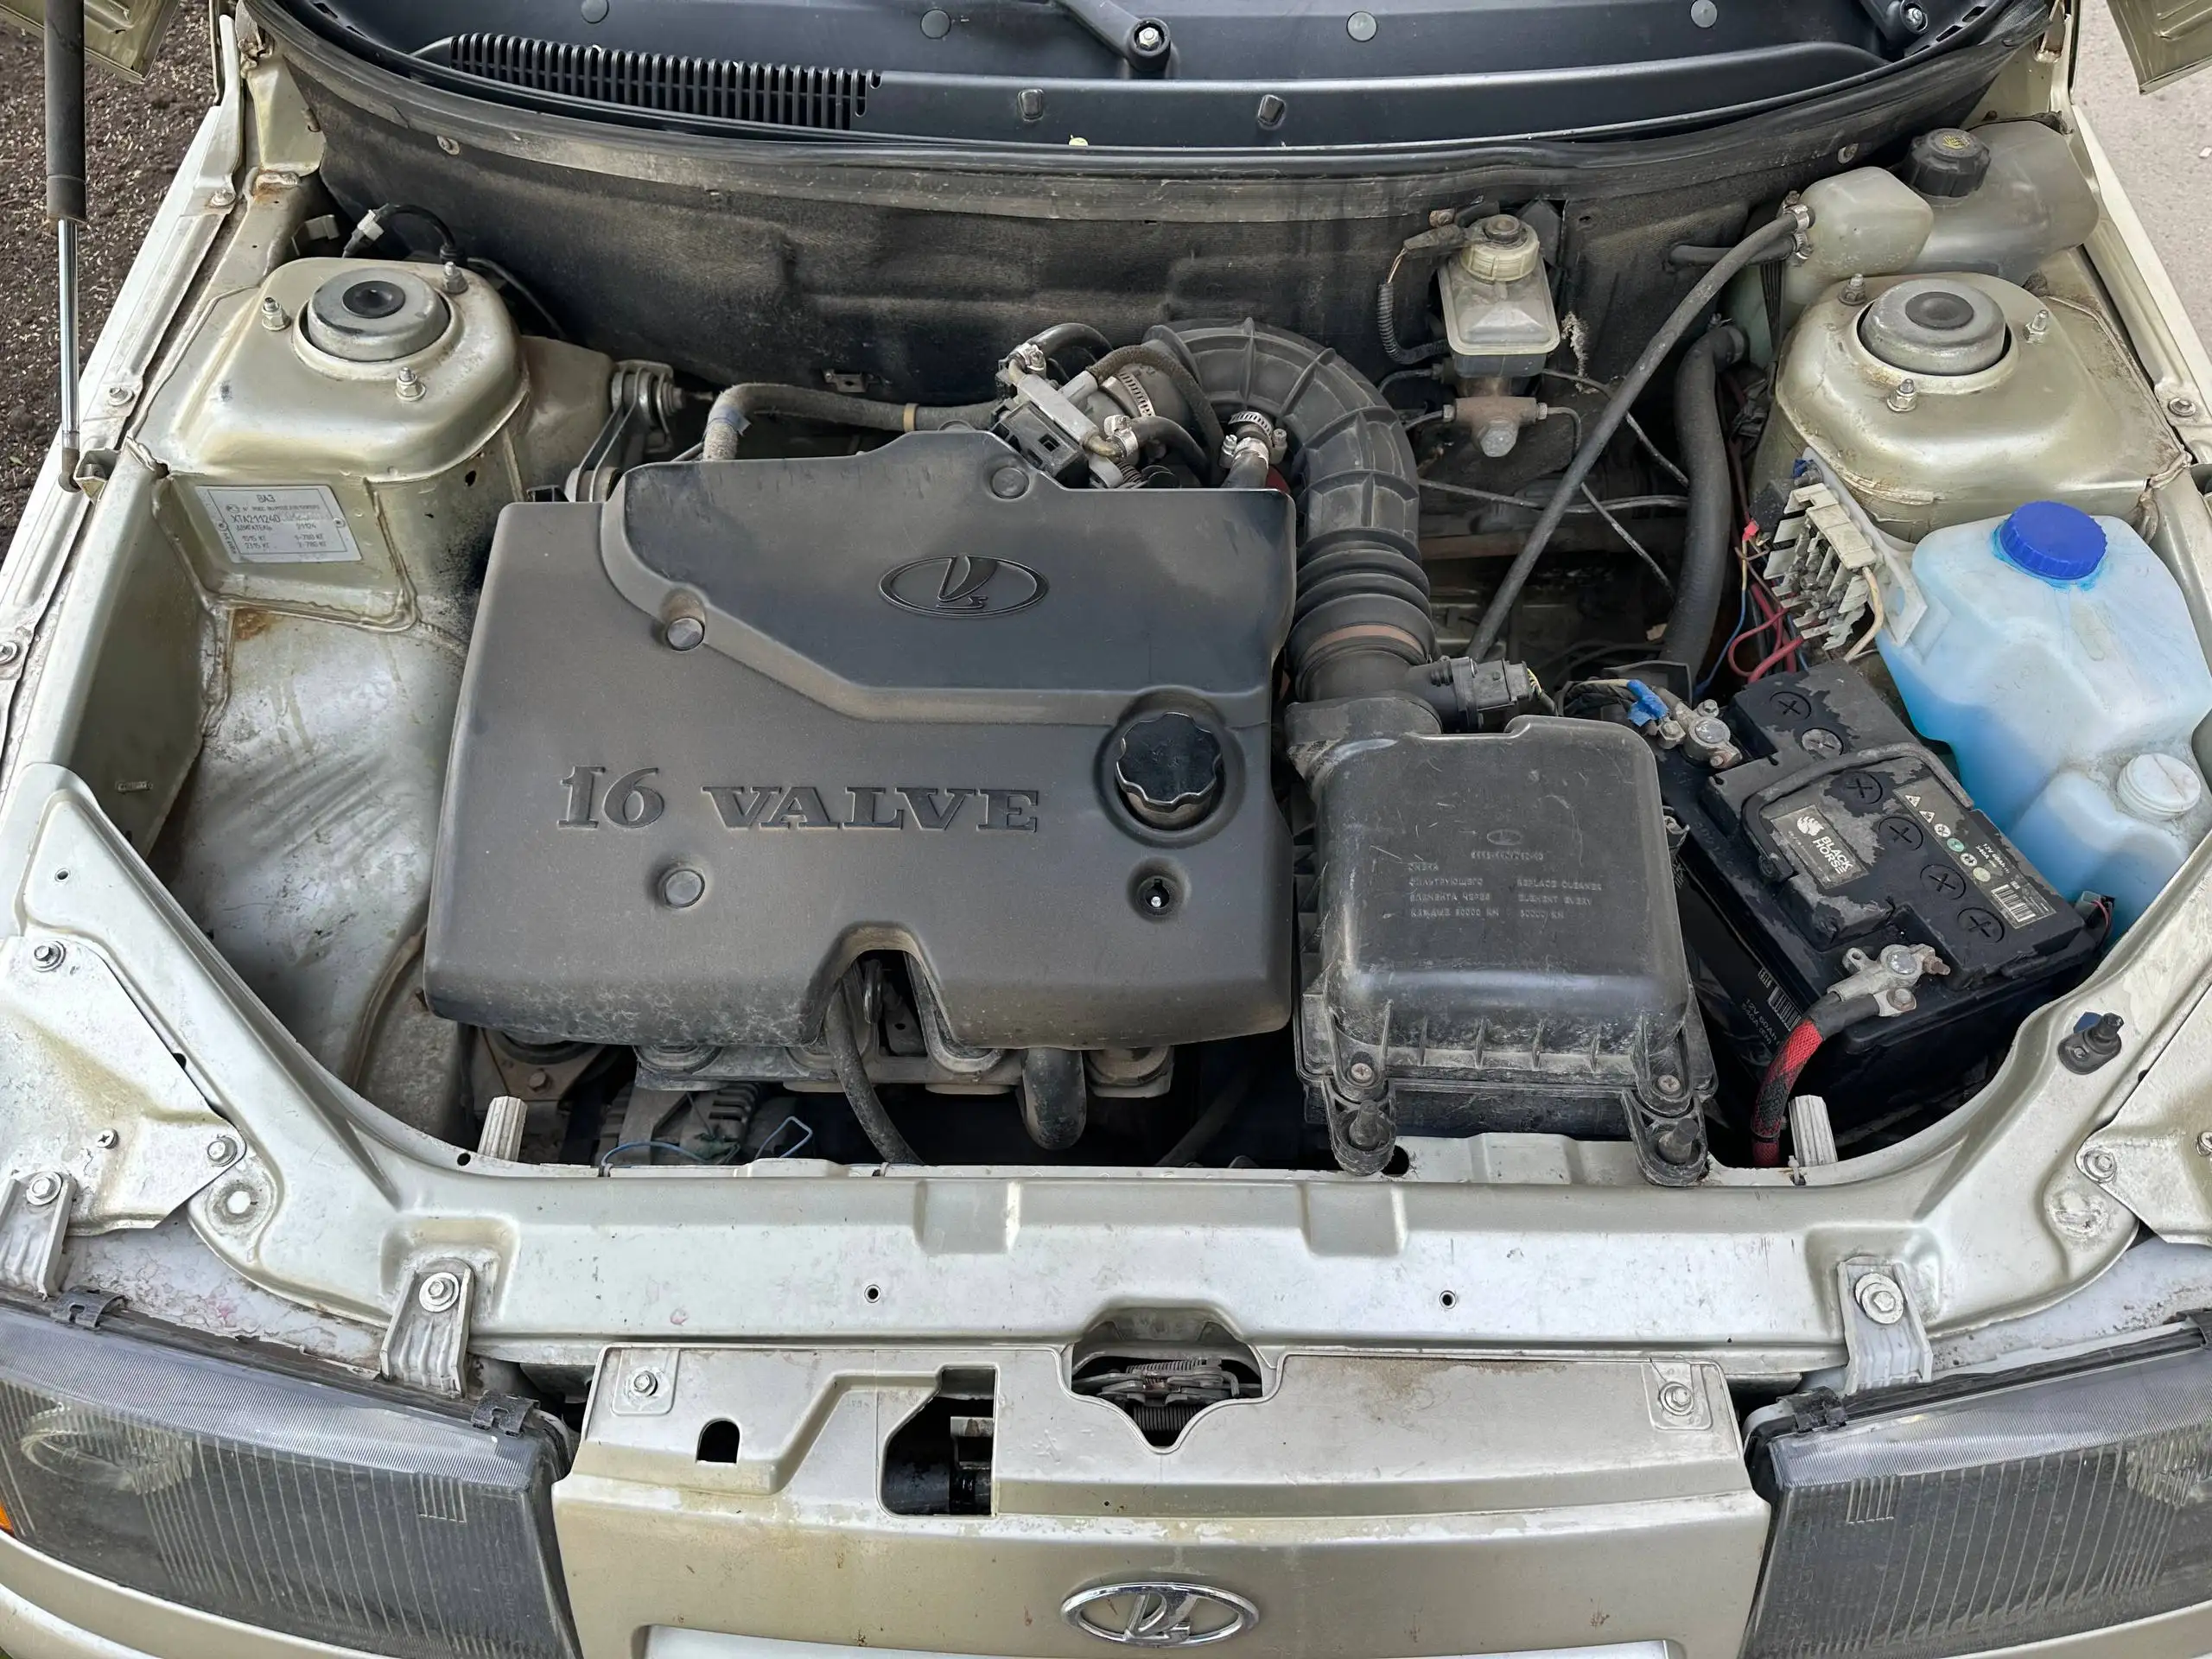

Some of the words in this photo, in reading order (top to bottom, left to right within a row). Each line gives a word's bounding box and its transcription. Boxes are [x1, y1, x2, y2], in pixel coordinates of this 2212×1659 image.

[557, 766, 664, 830] 16
[701, 785, 1039, 832] VALVE
[1812, 838, 1847, 875] HORSE
[1821, 836, 1853, 872] BLACK
